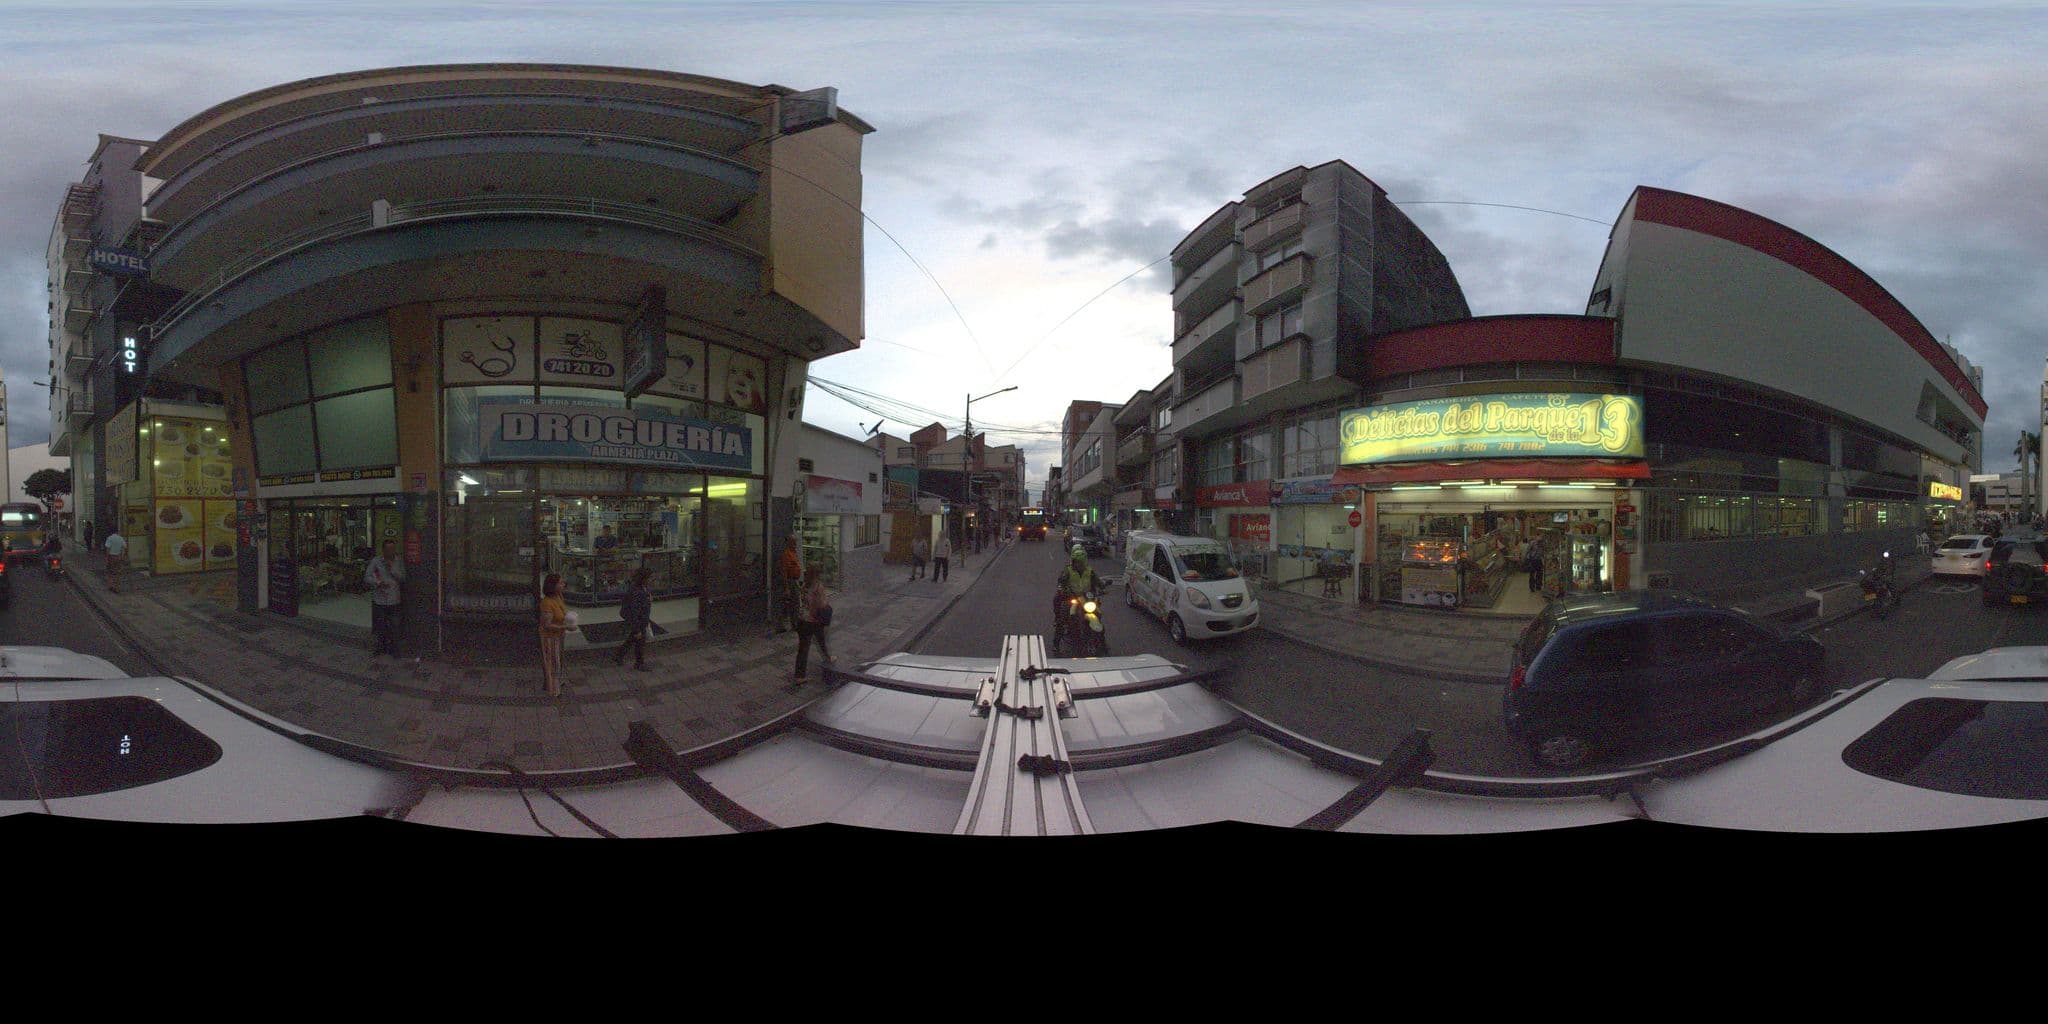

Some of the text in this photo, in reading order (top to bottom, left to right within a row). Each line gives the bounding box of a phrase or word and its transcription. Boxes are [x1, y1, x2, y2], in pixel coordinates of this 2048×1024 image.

[94, 250, 148, 270] HOTEL
[124, 337, 136, 373] HOT
[550, 360, 610, 374] 741 20 20
[502, 412, 744, 456] DROGUERÍA
[1353, 397, 1631, 452] Delicias del Parque 13
[591, 445, 679, 462] ARMENIA PLAZA
[1213, 490, 1240, 501] Avianca
